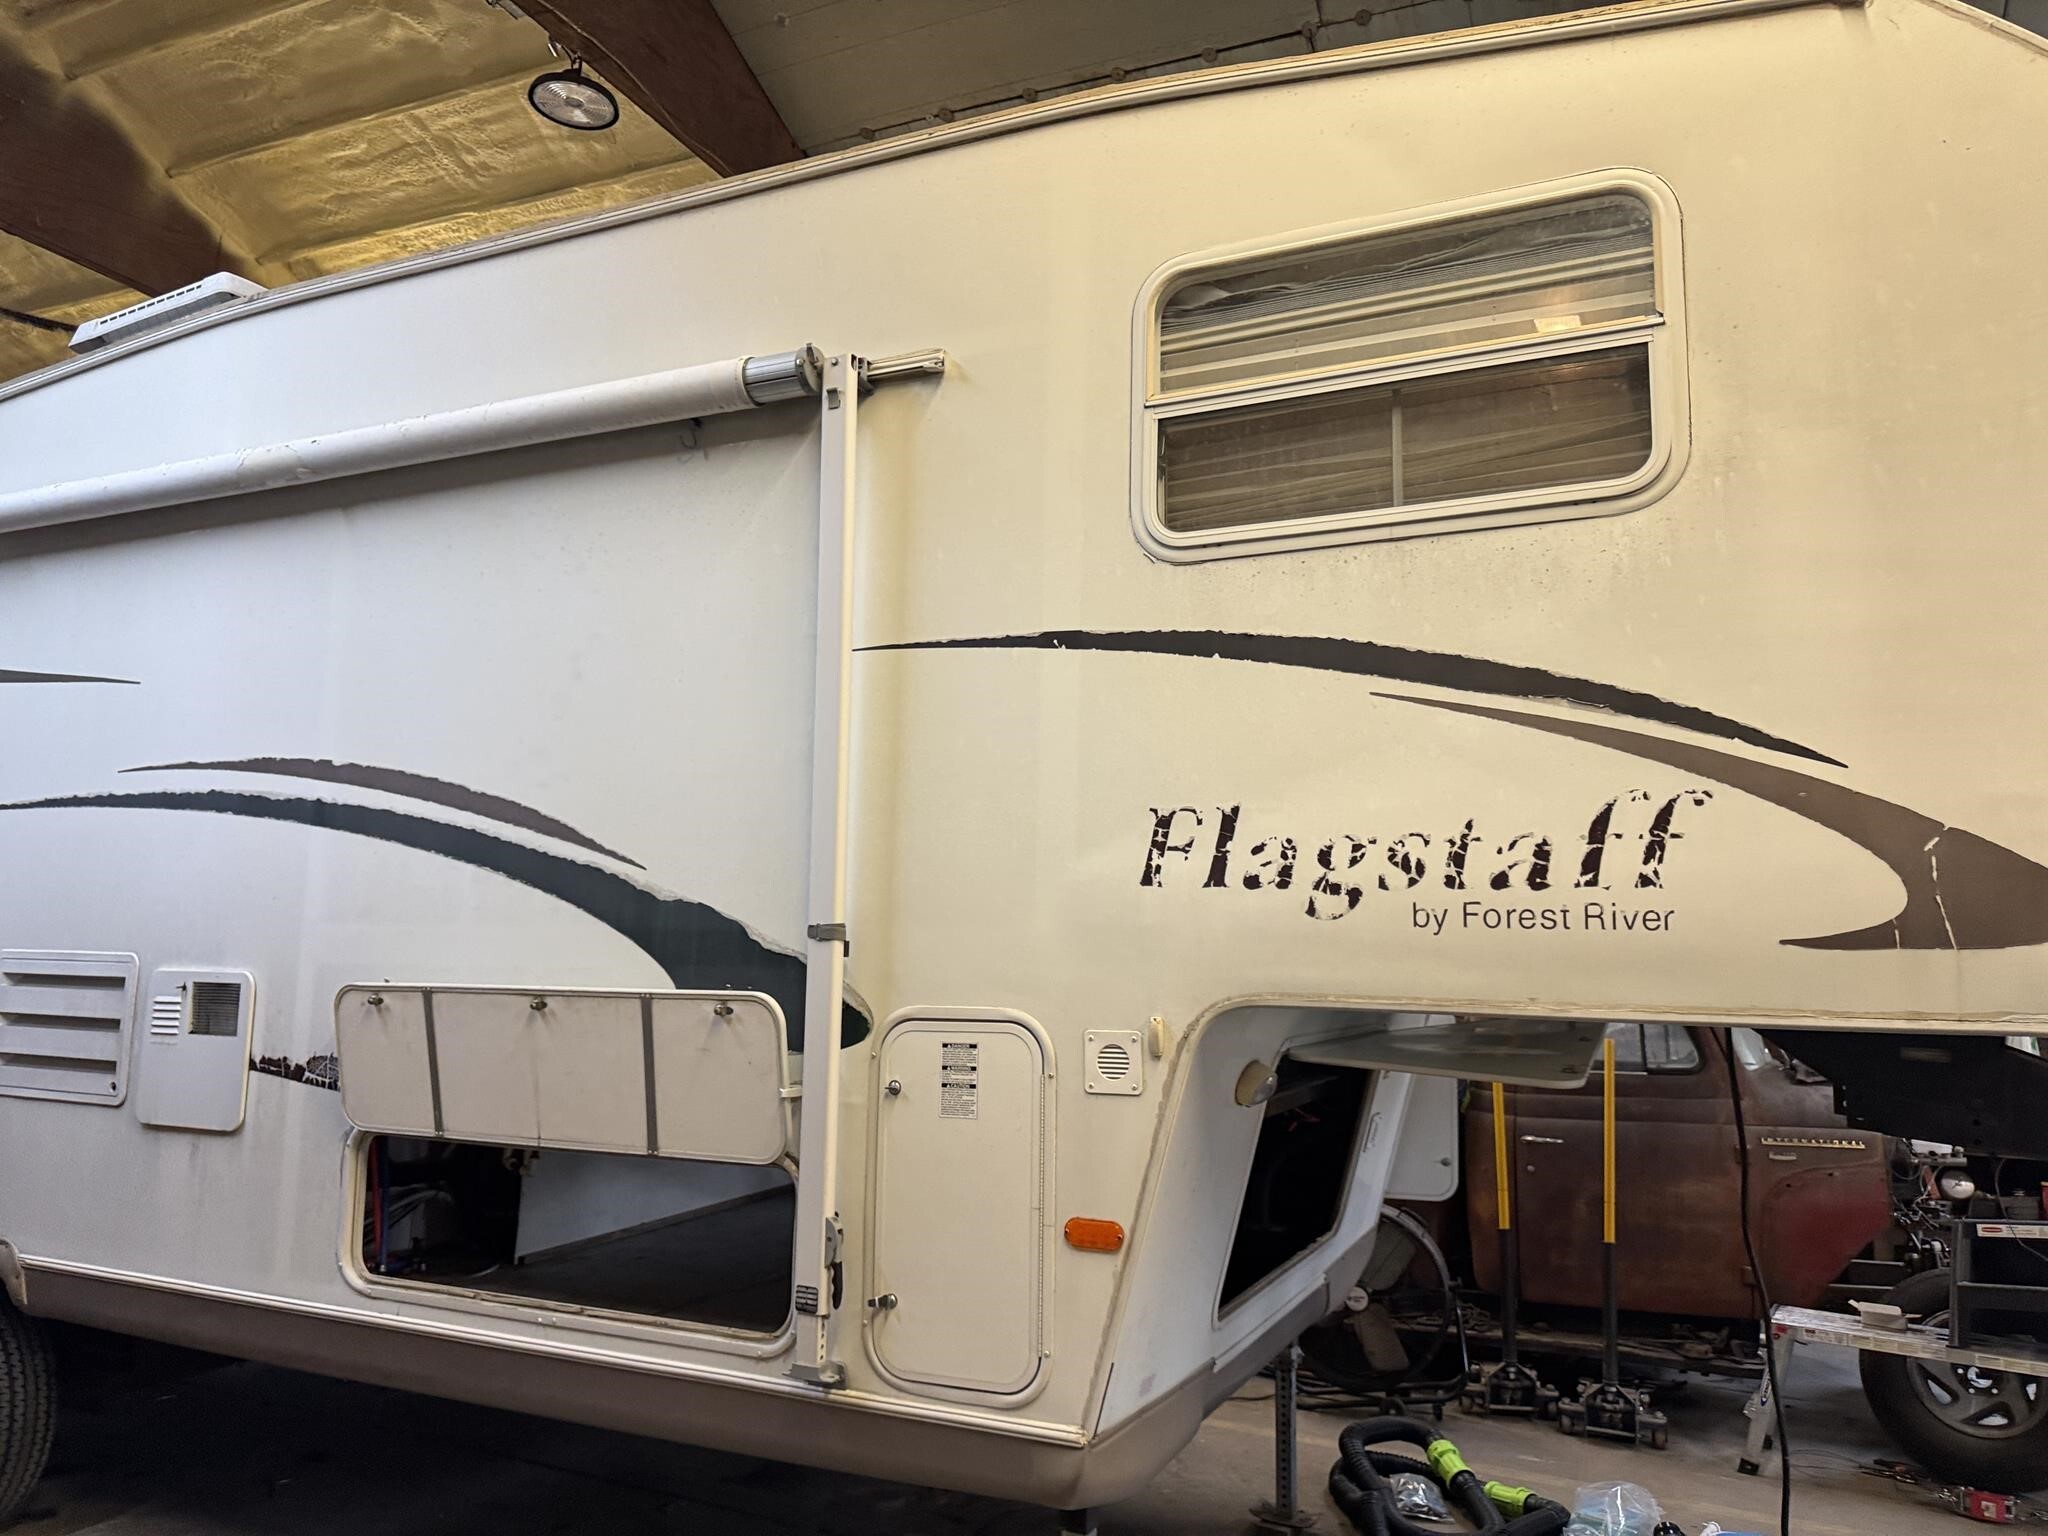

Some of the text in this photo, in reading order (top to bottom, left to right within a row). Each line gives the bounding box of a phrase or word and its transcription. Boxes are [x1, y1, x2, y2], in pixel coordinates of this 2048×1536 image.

[1139, 789, 1714, 921] Flagstaff
[1412, 901, 1675, 936] by Forest River
